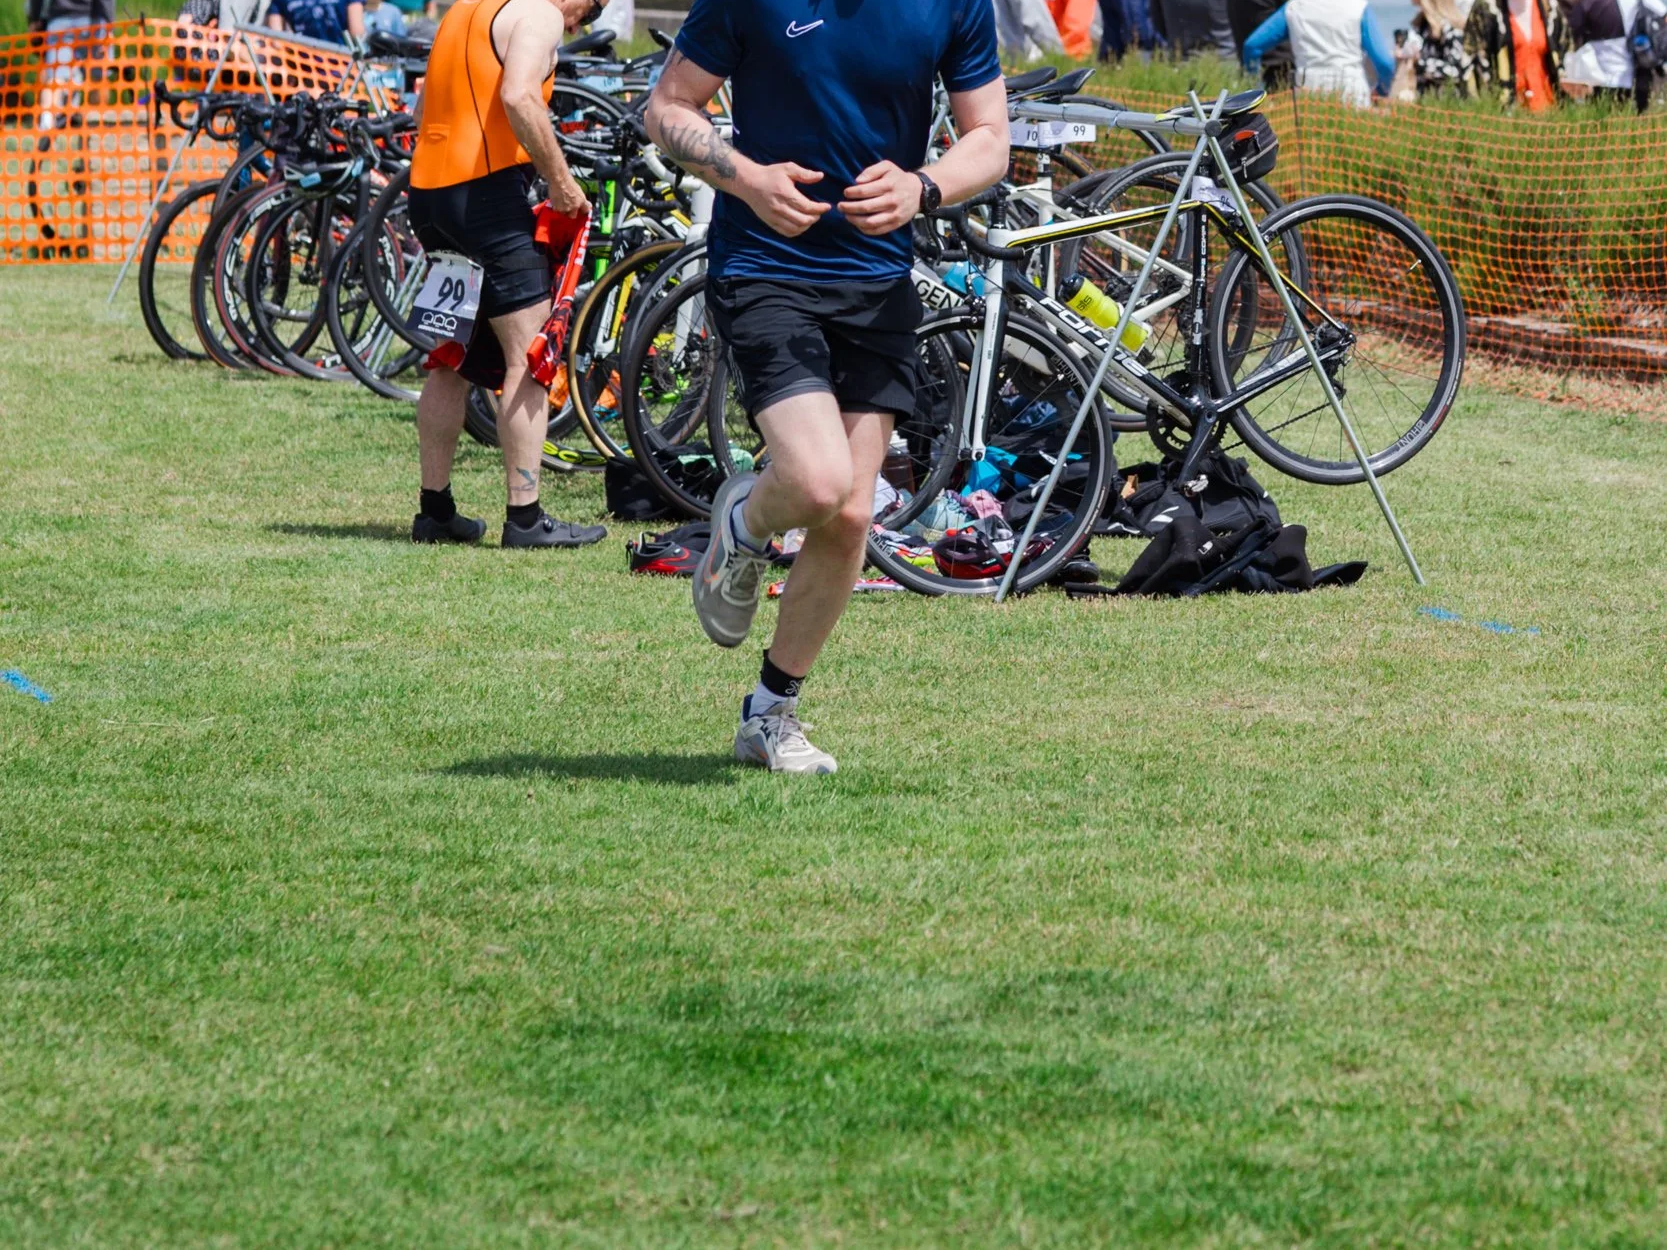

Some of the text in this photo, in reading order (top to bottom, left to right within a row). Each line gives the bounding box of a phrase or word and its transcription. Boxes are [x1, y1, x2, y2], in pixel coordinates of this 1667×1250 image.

[1073, 125, 1086, 136] 99
[433, 276, 466, 311] 99
[1057, 359, 1081, 387] HUNT
